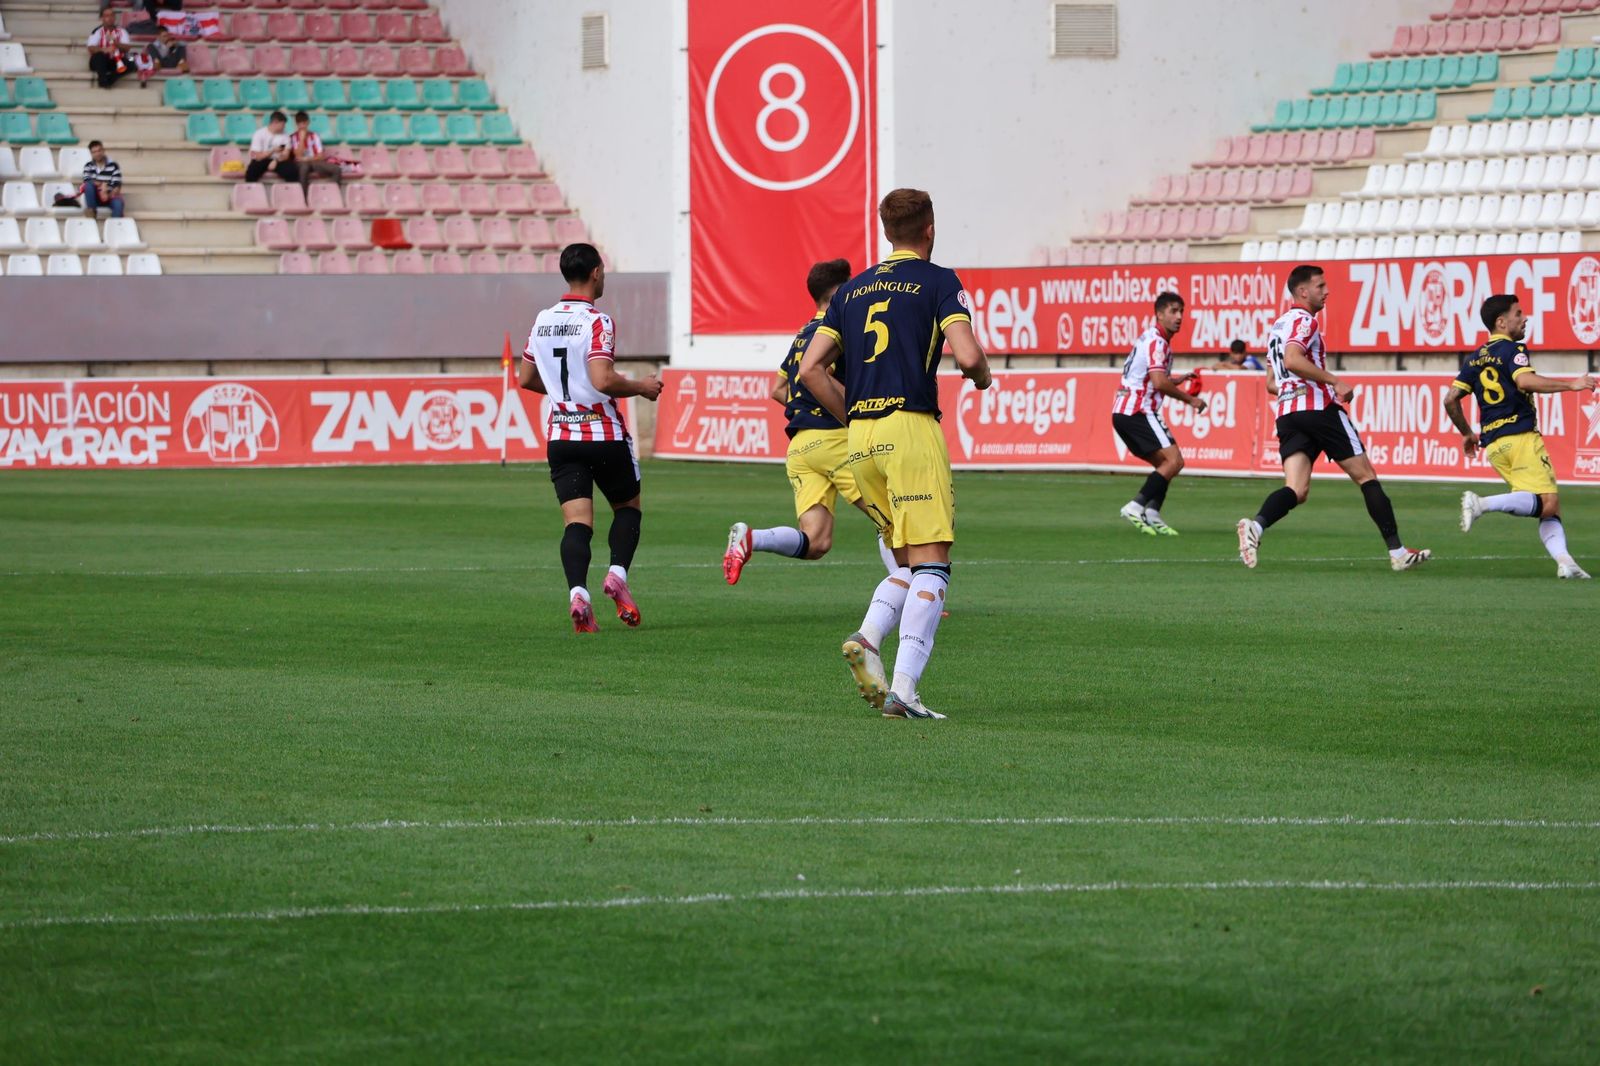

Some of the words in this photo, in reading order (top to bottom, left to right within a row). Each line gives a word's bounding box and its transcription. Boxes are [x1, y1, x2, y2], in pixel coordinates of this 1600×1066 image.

[756, 62, 809, 152] 8
[852, 278, 921, 299] DOMÍNGUEZ
[1041, 270, 1179, 305] www.cubiex.es
[1190, 266, 1276, 306] FUNDACIÓN
[1350, 260, 1494, 347] ZAMORA
[1505, 257, 1561, 346] CF
[537, 325, 552, 337] KIKE
[553, 321, 583, 337] MÁRQUEZ
[863, 297, 892, 363] 5
[1081, 316, 1107, 347] 675
[1111, 315, 1138, 346] 630
[552, 347, 572, 402] 7
[1479, 365, 1506, 405] 8
[0, 384, 171, 425] UNDACIÓN
[310, 388, 540, 453] ZAMORA
[976, 377, 1078, 436] Freigel
[1351, 383, 1434, 434] CAMINO
[694, 416, 770, 455] ZAMORA
[1392, 436, 1419, 466] del
[1423, 438, 1460, 467] Vino
